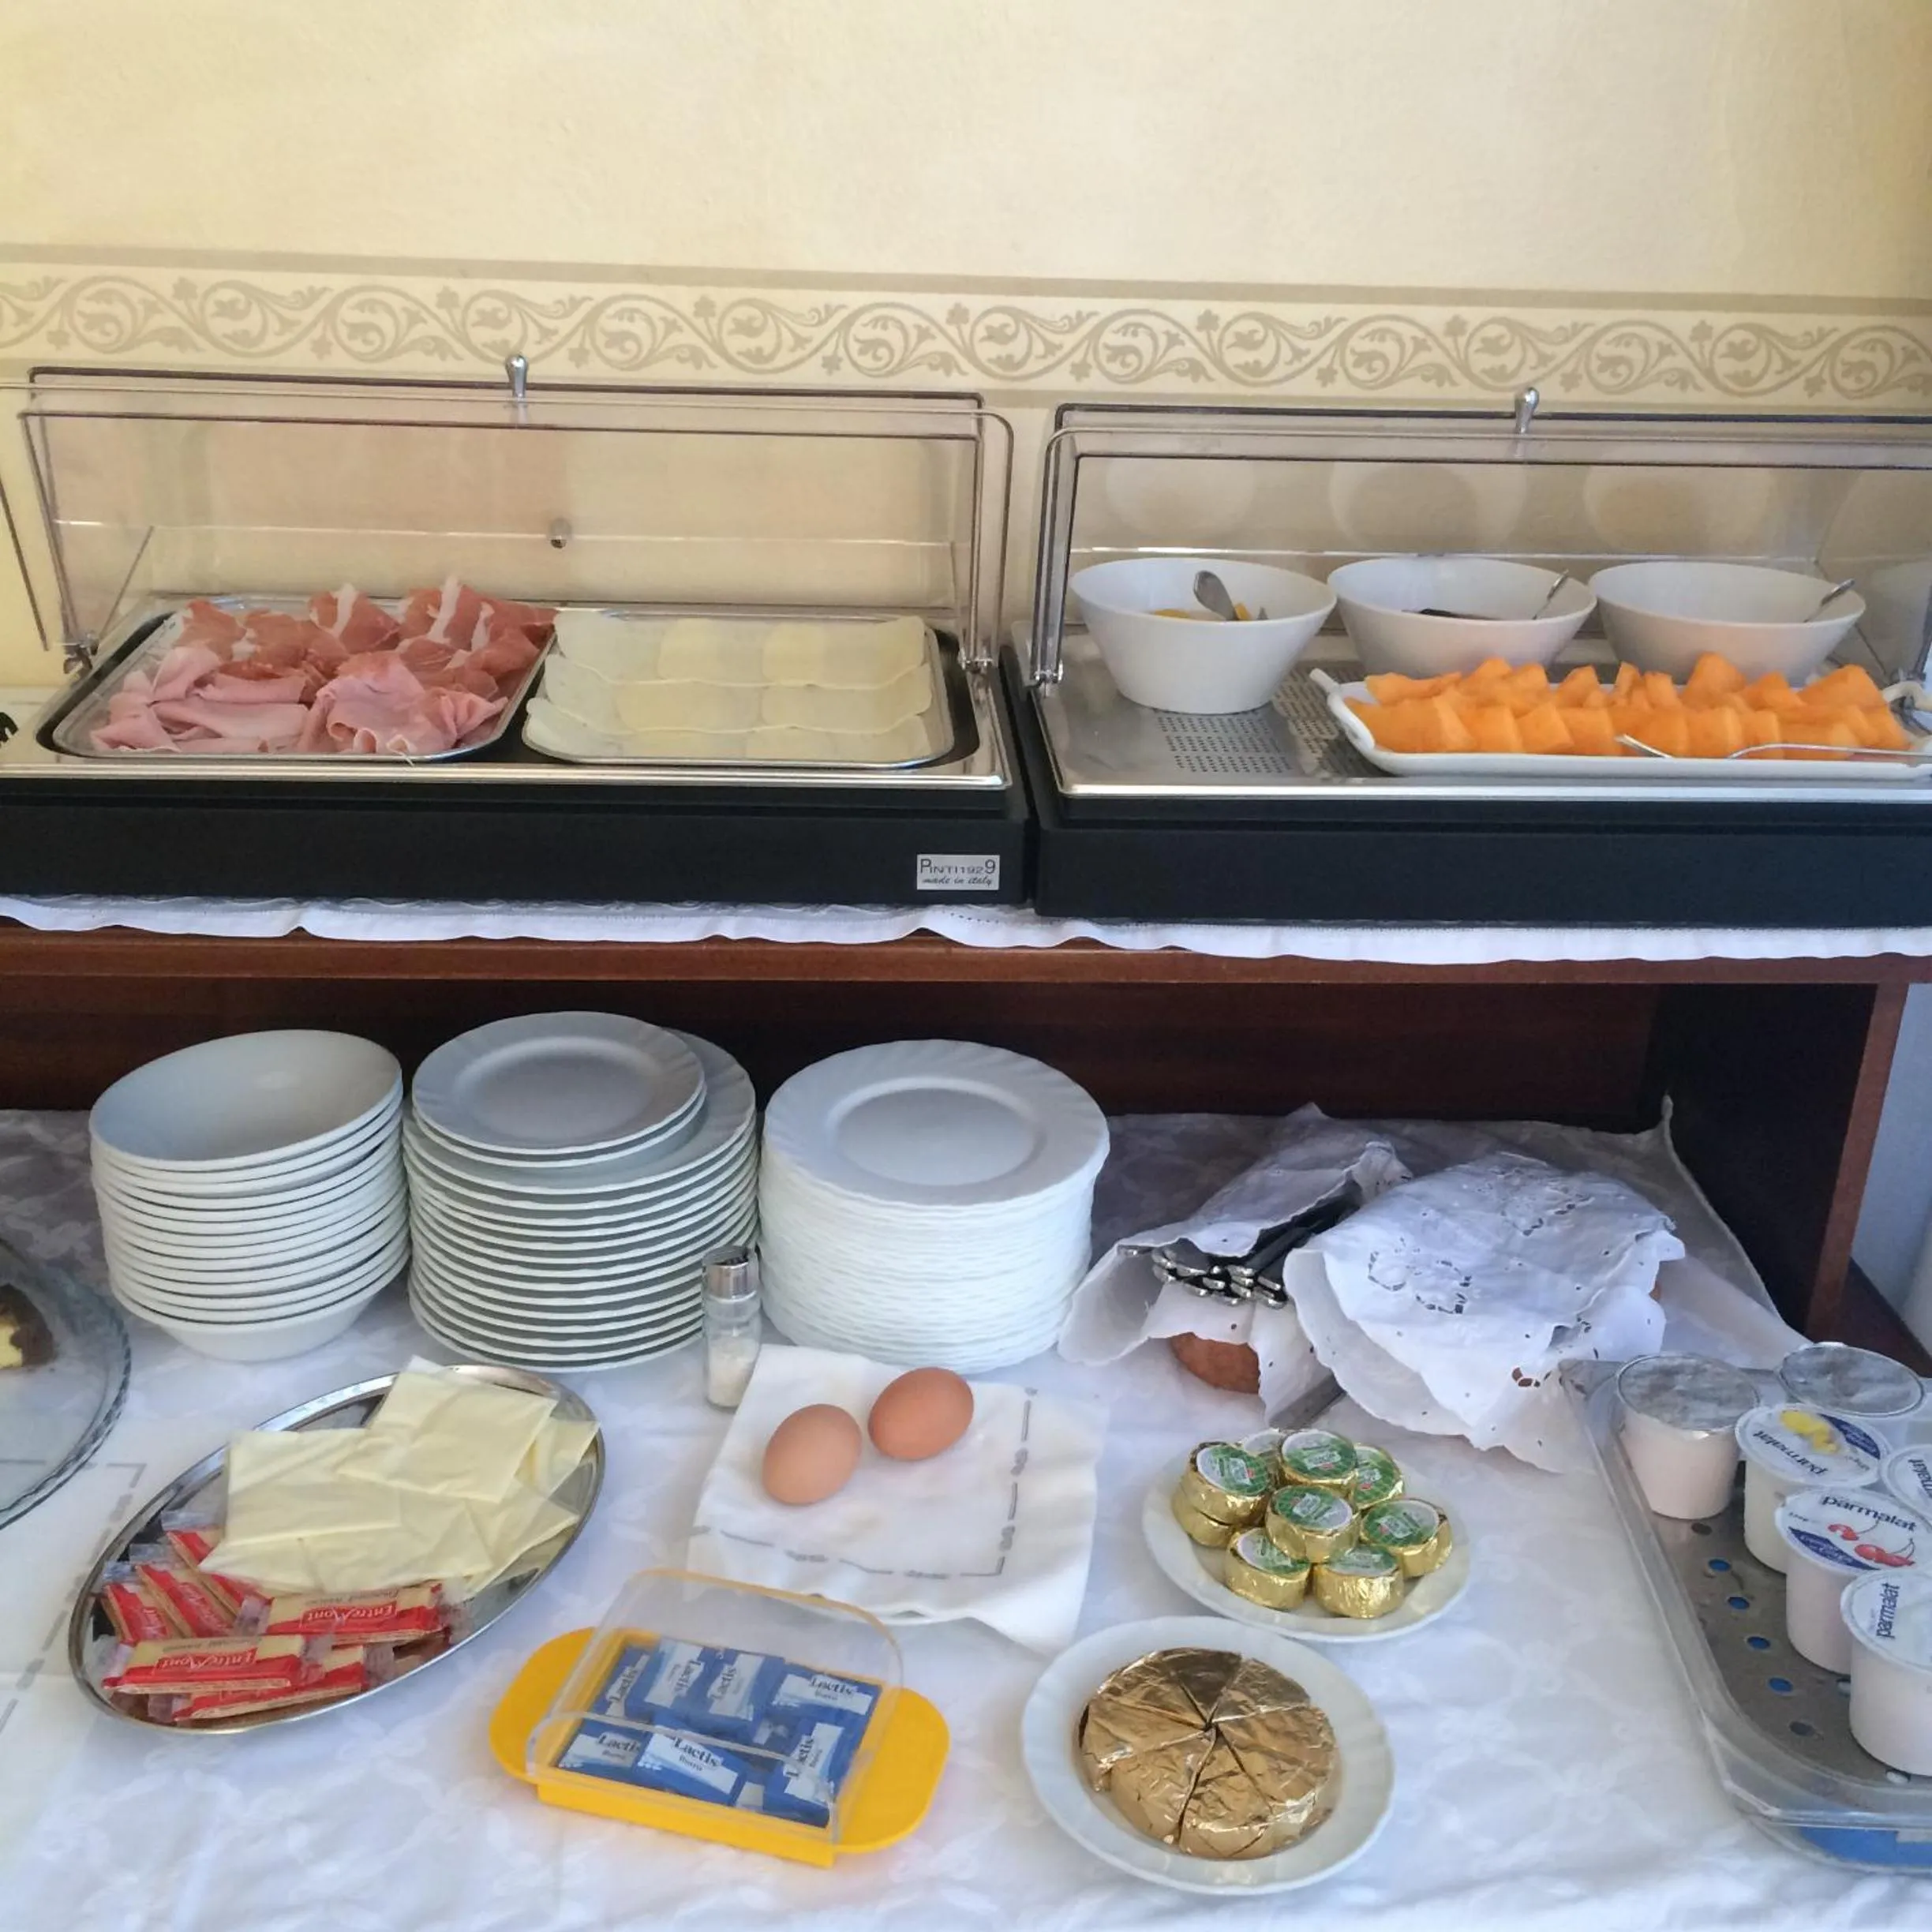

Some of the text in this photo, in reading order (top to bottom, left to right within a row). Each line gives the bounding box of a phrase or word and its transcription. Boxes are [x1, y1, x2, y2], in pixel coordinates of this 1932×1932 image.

[1753, 1430, 1828, 1475] parmalat
[1822, 1496, 1917, 1532] parmalat
[1876, 1582, 1900, 1639] parmalat
[673, 1735, 721, 1769] Lactis
